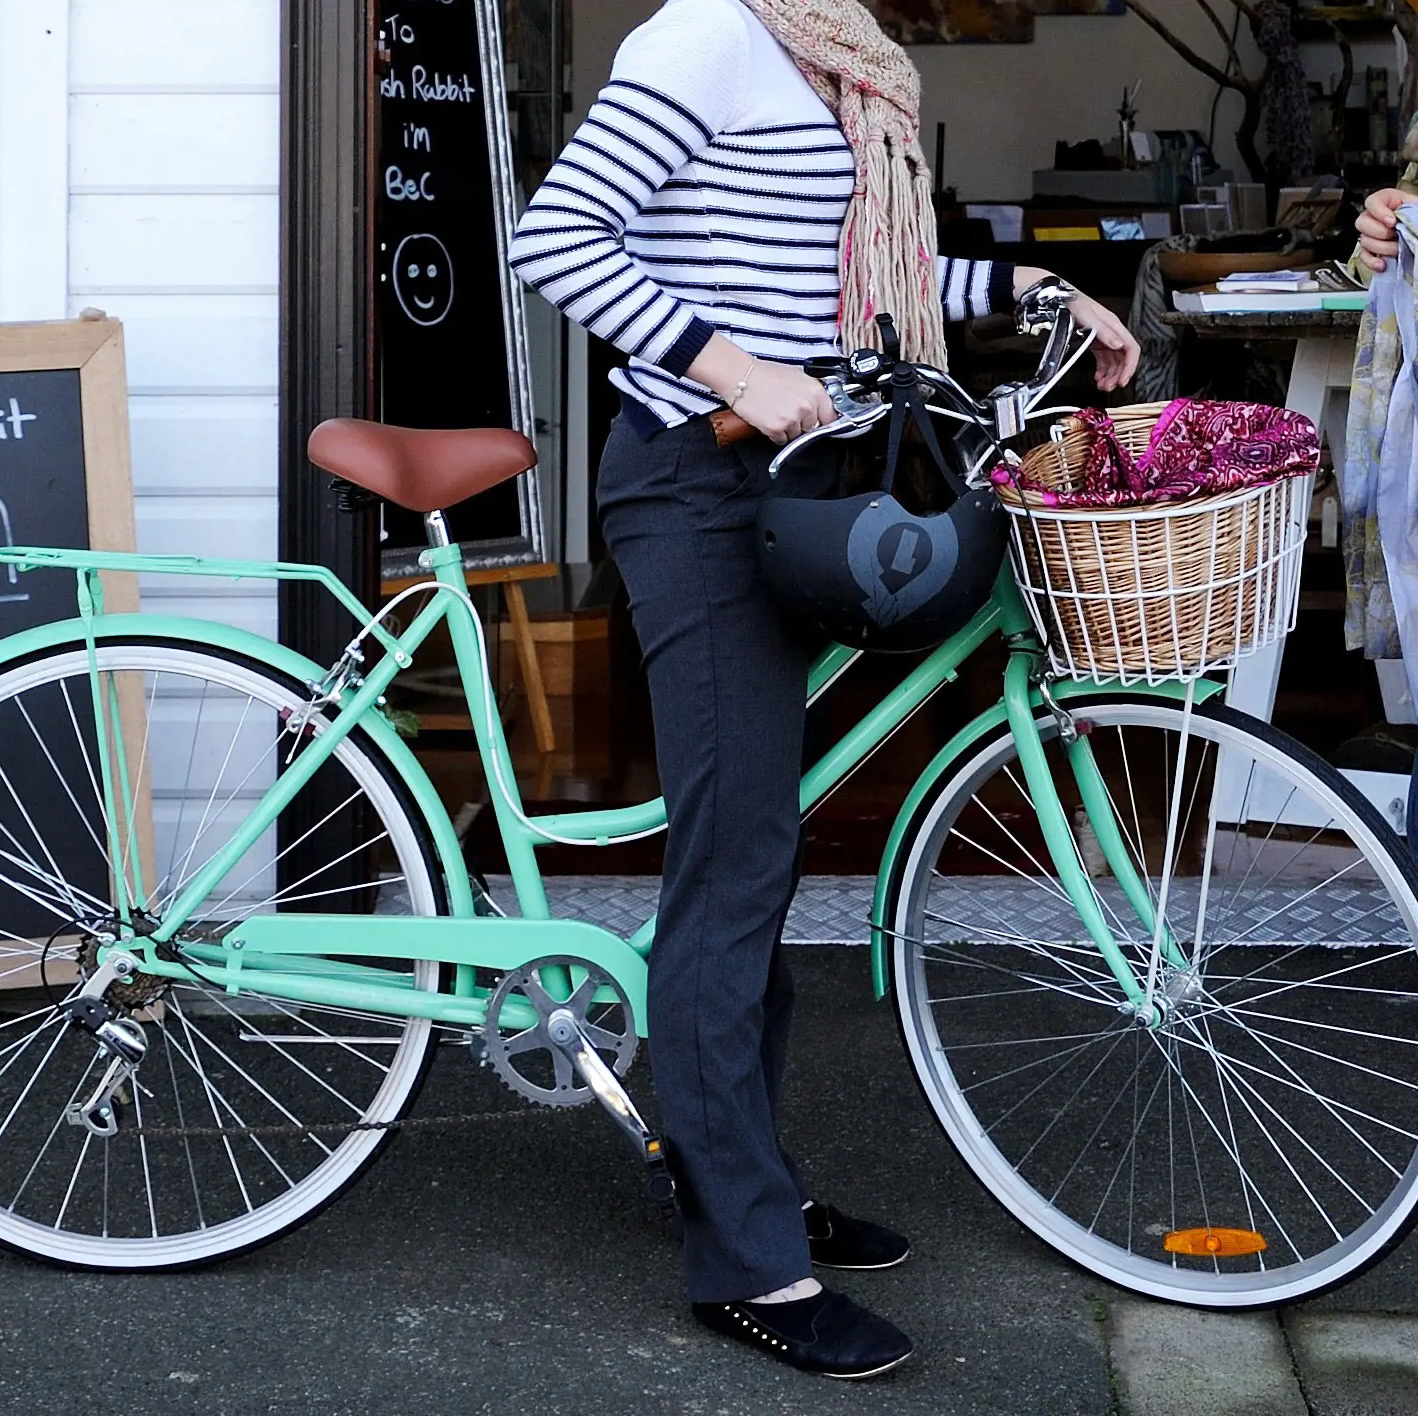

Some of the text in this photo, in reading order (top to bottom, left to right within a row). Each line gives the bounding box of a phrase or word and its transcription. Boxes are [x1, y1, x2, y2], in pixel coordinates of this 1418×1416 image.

[385, 14, 415, 43] To
[380, 64, 475, 103] sh Rabbit
